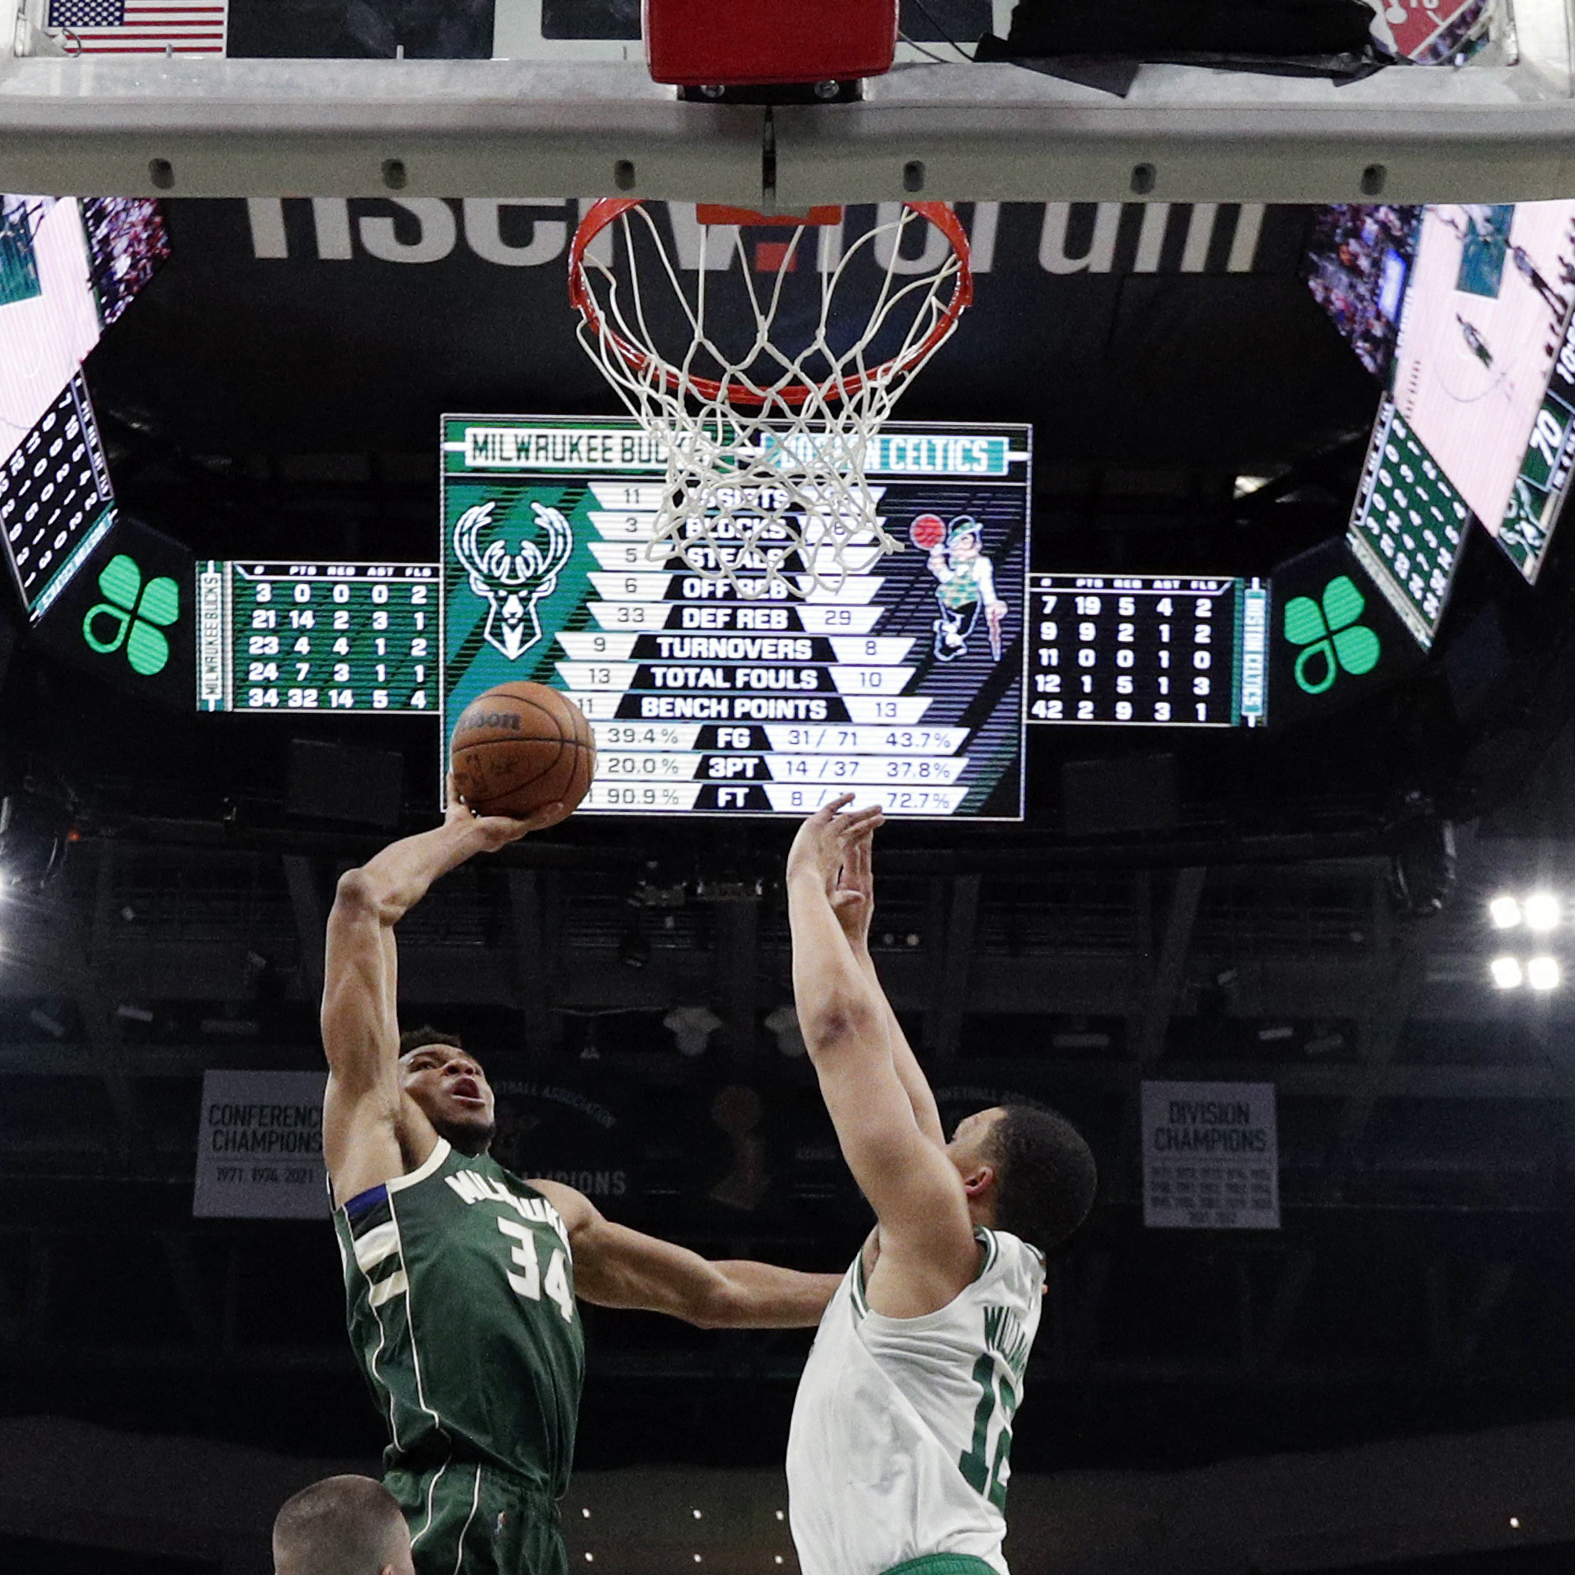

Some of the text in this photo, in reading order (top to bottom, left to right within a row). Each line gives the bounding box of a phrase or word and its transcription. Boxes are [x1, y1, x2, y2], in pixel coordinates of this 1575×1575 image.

[473, 433, 612, 462] MILWAUKEE
[1530, 409, 1563, 466] 70
[890, 439, 988, 472] CELTICS
[625, 490, 640, 504] 11
[626, 519, 638, 532] 3
[626, 548, 638, 562] 5
[256, 584, 427, 604] 3 0 0 0 2
[626, 579, 637, 593] 6
[683, 578, 730, 598] OFF
[1041, 595, 1212, 618] 7 19 5 4 2
[252, 610, 424, 631] 21 14 2 3 1
[617, 608, 851, 629] 33 DEF REB 29
[205, 621, 219, 696] MILWAUKEE
[594, 637, 876, 660] 9 TURNOVERS 8
[588, 667, 882, 689] 13 TOTAL FOULS 10
[248, 688, 427, 709] 34 32 14 5 4
[577, 697, 897, 719] 11 BENCH POINTS 13
[1031, 700, 1207, 722] 42 2 9 3 1
[717, 728, 750, 748] FG
[885, 732, 950, 748] 43.7%
[709, 757, 759, 778] 3PT
[786, 760, 808, 776] 14
[887, 762, 950, 778] 37.8%
[717, 787, 749, 808] FT
[791, 791, 803, 806] 8
[887, 792, 950, 809] 72.7%
[1169, 1101, 1250, 1124] DIVISION
[213, 1129, 322, 1153] CHAMPIONS
[1154, 1128, 1267, 1152] CHAMPIONS
[497, 1216, 573, 1323] 34
